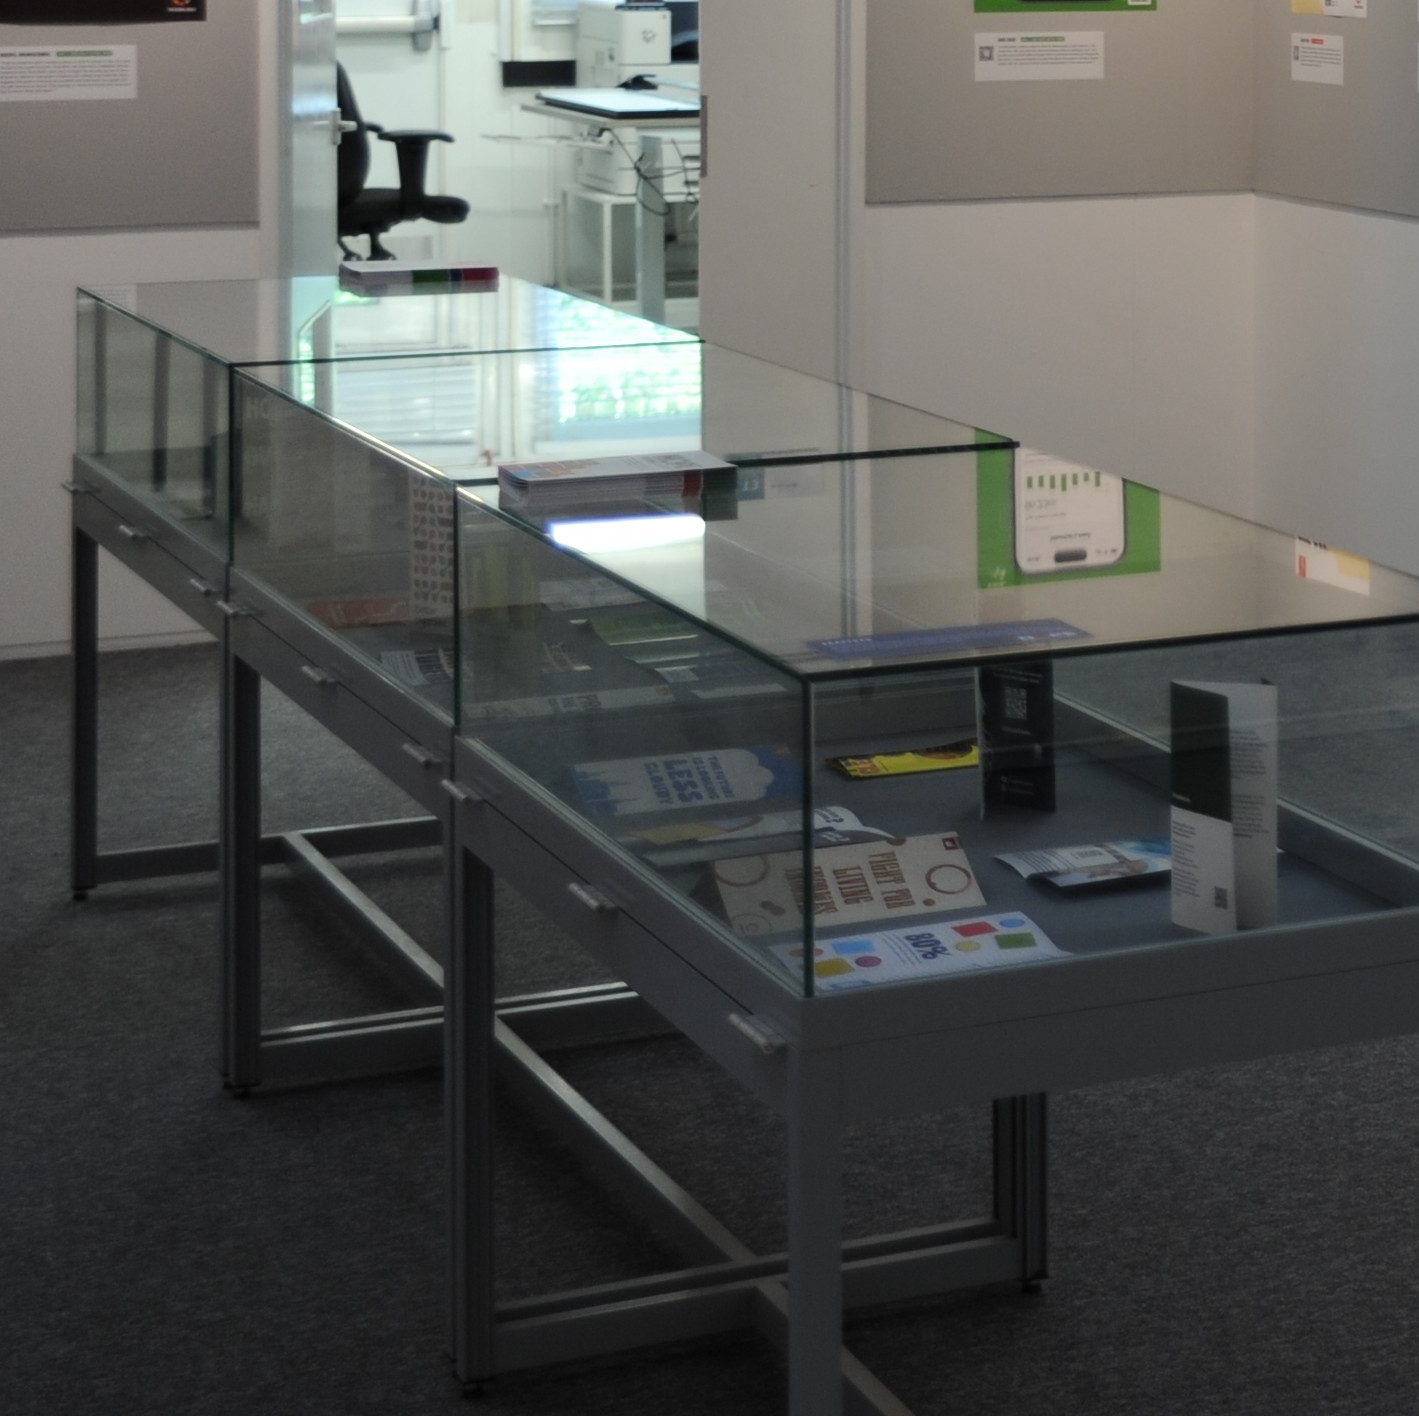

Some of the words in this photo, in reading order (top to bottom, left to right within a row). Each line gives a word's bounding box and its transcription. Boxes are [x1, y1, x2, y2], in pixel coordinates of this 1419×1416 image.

[663, 759, 703, 803] LESS
[832, 866, 874, 904] LIVING
[868, 851, 905, 885] FIGHT
[881, 888, 915, 909] FOR
[905, 932, 952, 960] 80%
